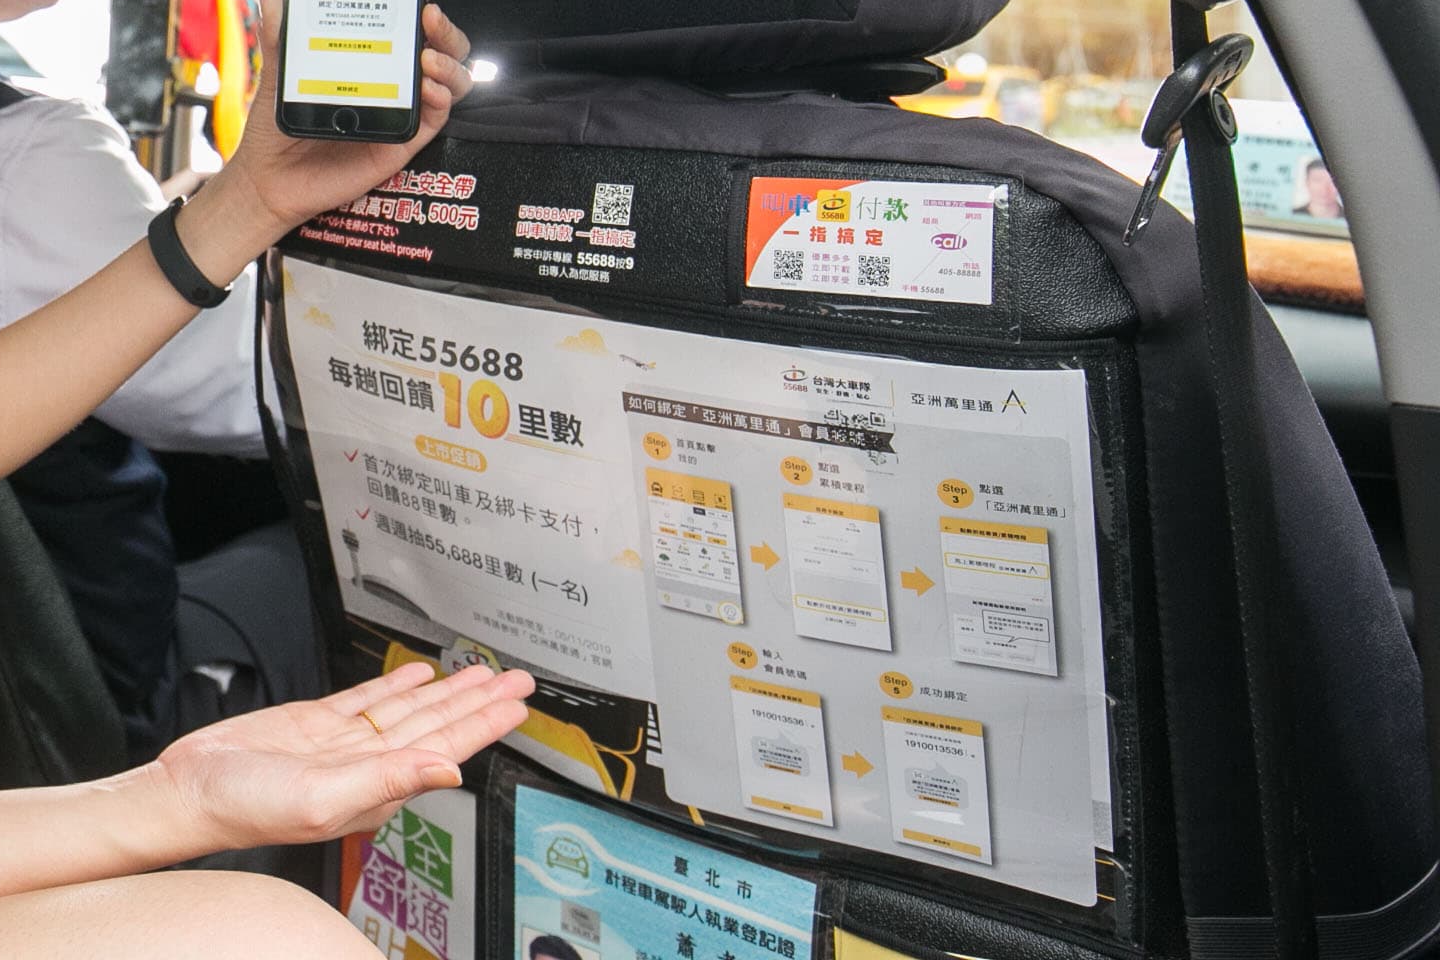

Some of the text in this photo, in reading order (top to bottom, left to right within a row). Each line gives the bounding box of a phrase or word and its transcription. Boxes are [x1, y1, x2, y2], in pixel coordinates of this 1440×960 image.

[375, 169, 477, 200] 繫上安全帶
[518, 204, 585, 223] 55688APP
[821, 211, 845, 220] 55688
[856, 196, 909, 222] 付款
[515, 221, 637, 248] 叫車付款 一指搞定
[783, 226, 884, 247] 一指搞定
[300, 226, 433, 262] Please fasten your seat belt properly
[931, 234, 964, 249] call
[920, 286, 945, 295] 55688
[362, 319, 524, 382] 綁定55688
[783, 382, 809, 393] 55688
[812, 375, 872, 393] 台灣大車隊
[910, 392, 995, 413] 亞洲萬里通
[646, 436, 667, 448] Step
[654, 448, 660, 456] 1
[784, 460, 808, 473] Step
[793, 472, 800, 481] 2
[942, 483, 968, 495] Step
[978, 483, 1004, 496] 點選
[952, 495, 960, 504] 3
[731, 645, 753, 658] Step
[739, 657, 746, 665] 4
[884, 675, 908, 687] Step
[893, 686, 900, 695] 5
[919, 686, 968, 702] 成功綁定
[672, 854, 753, 901] 臺北市
[604, 867, 797, 960] 計程車駕駛人執業登記證
